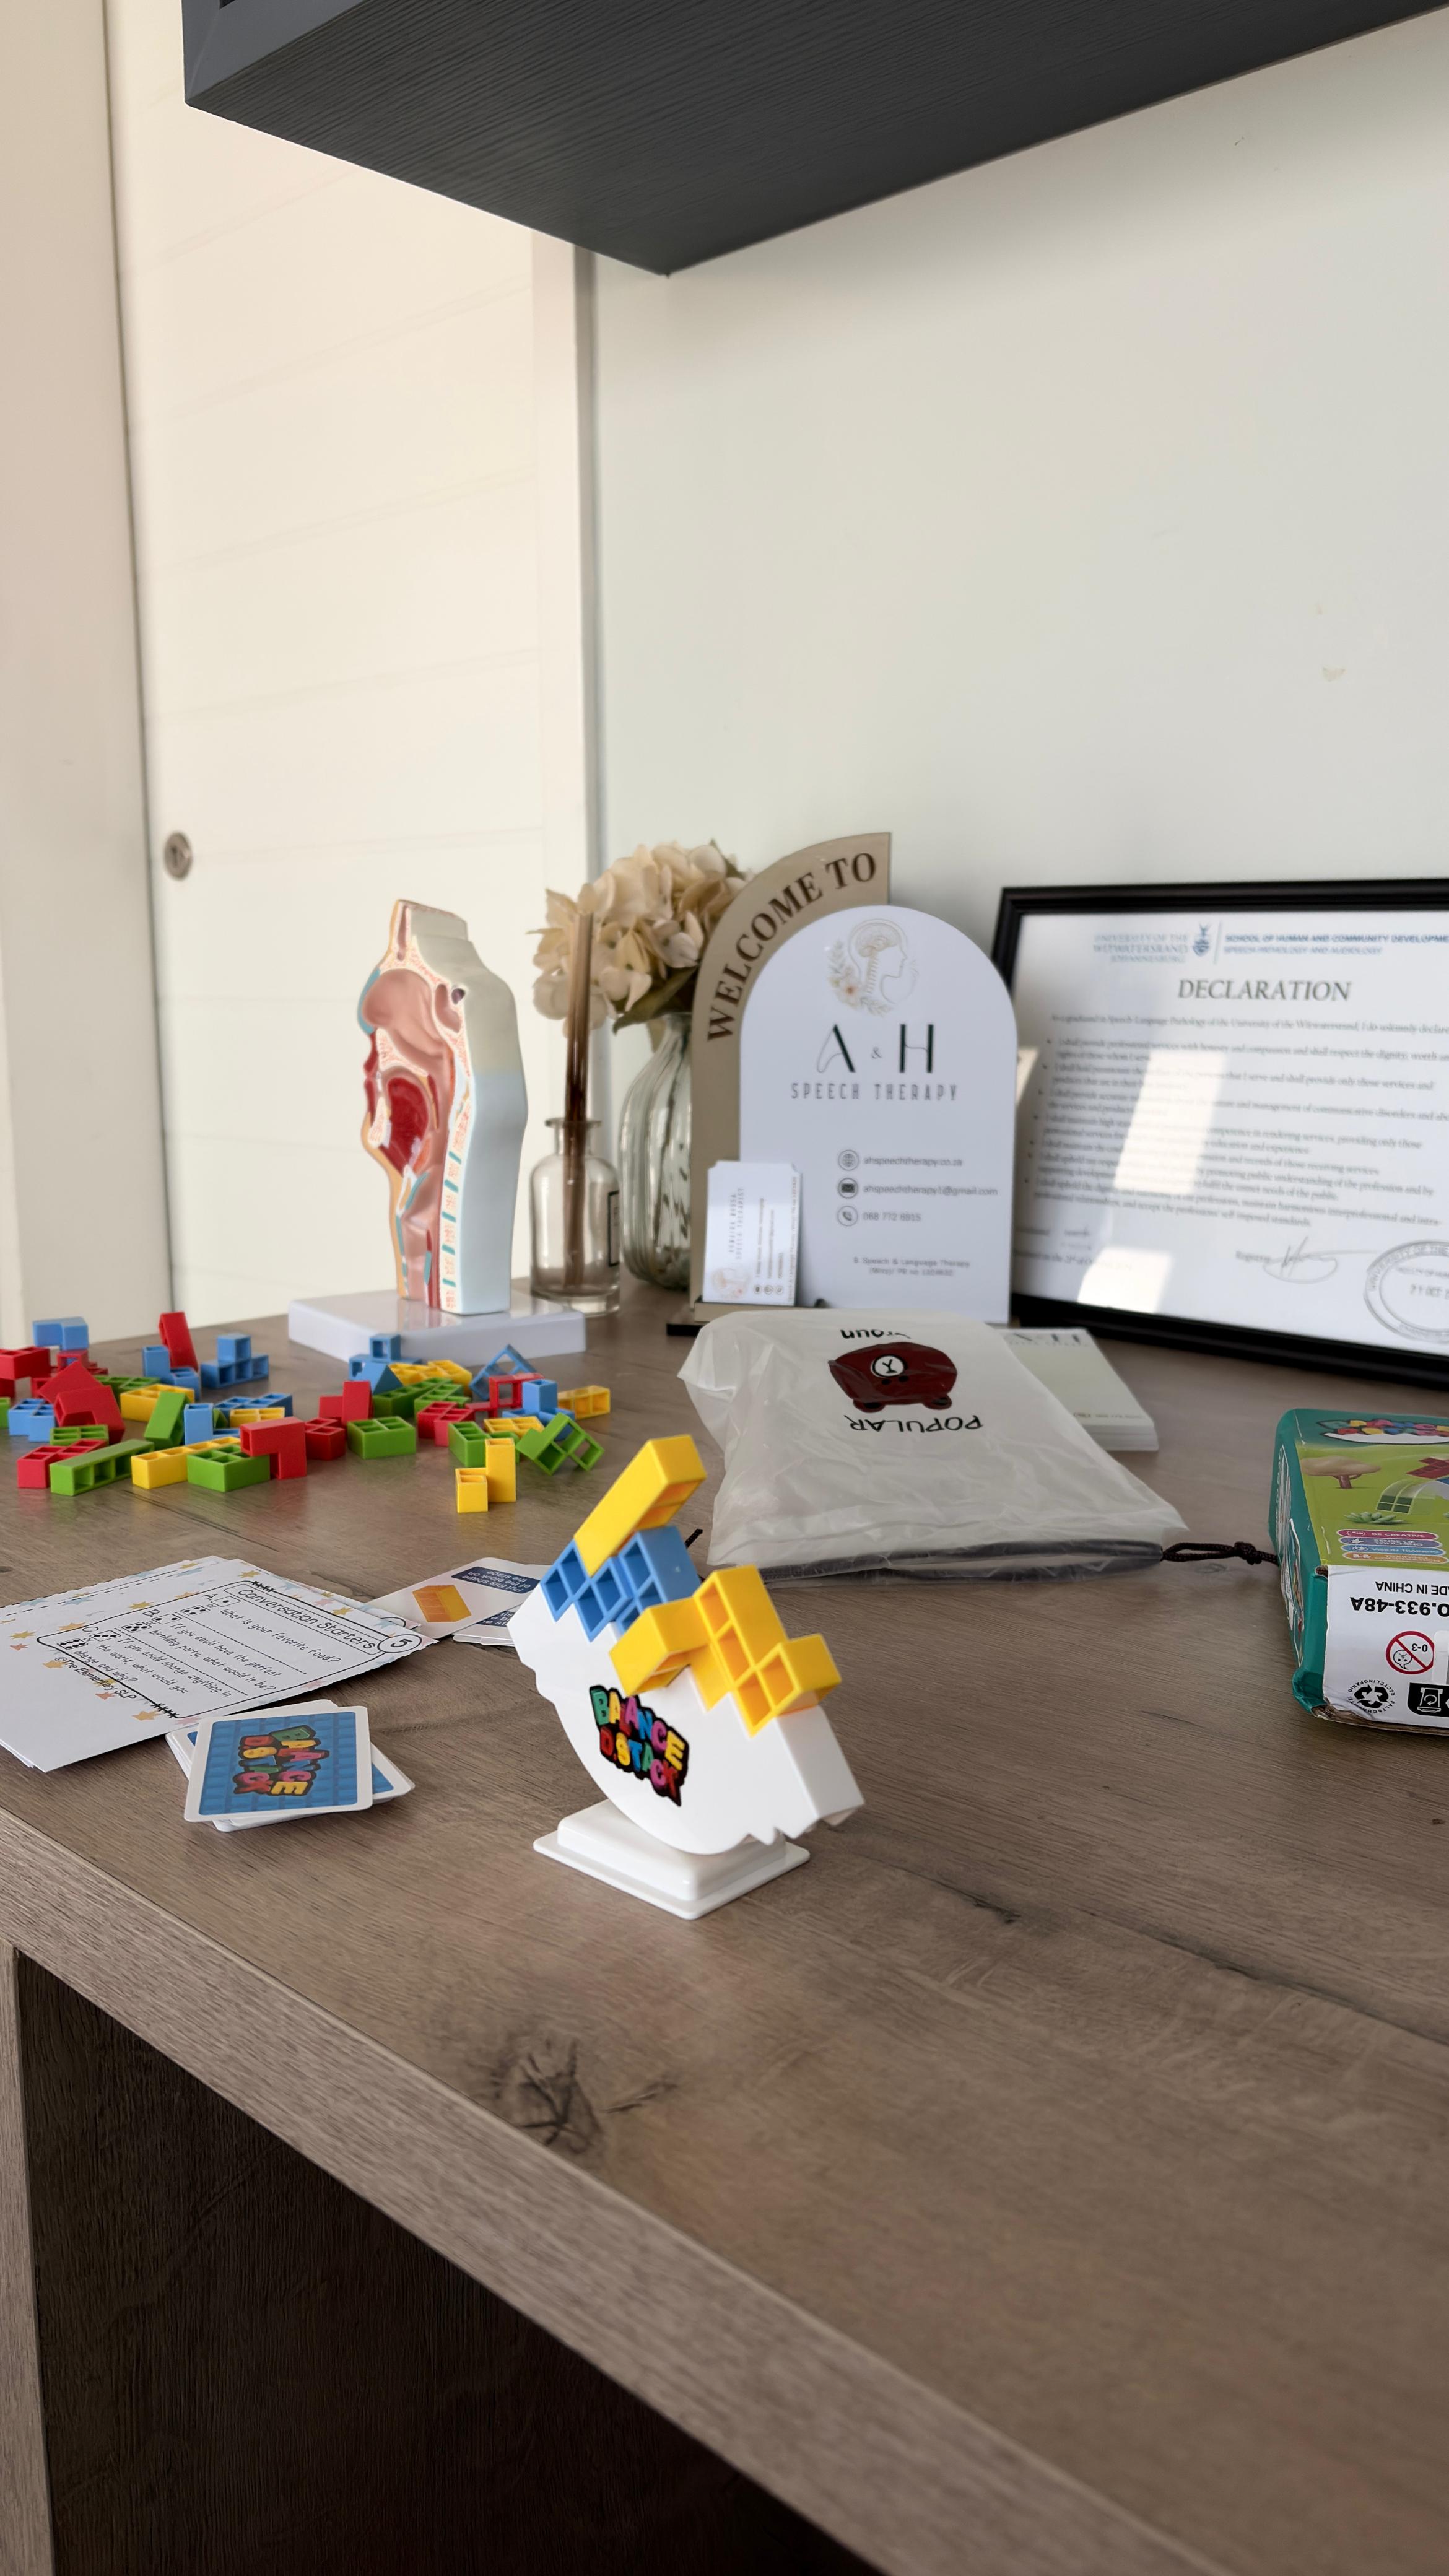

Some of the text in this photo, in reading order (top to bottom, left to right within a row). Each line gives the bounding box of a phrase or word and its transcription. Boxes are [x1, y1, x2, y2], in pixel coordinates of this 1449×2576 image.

[707, 853, 877, 1042] WELCOME TO
[1332, 935, 1388, 944] COMMUNITY
[1391, 935, 1449, 944] DEVELOPME
[1177, 978, 1352, 1002] DECLARATION
[817, 1024, 934, 1074] A & H
[791, 1082, 958, 1101] SPEECH THERAPY
[843, 1415, 983, 1433] POPULAR
[461, 1575, 523, 1593] Put this shape
[482, 1575, 505, 1583] block
[486, 1570, 512, 1579] stage
[201, 1593, 215, 1601] A.
[1375, 1581, 1449, 1596] DE IN CHINA
[142, 1609, 160, 1618] B.
[1349, 1596, 1449, 1617] O.933-48A
[238, 1589, 376, 1650] Conversation Starters
[82, 1626, 99, 1635] C.
[220, 1608, 342, 1663] What is your favorite food?
[170, 1622, 282, 1678] If you could have the perfect
[391, 1638, 412, 1648] 5
[1411, 1643, 1428, 1653] 0-3
[72, 1650, 138, 1682] change and why?
[97, 1644, 189, 1695] the world, what would you
[118, 1636, 231, 1697] If you could change anything in
[149, 1629, 180, 1647] birthday
[177, 1642, 202, 1658] party,
[201, 1655, 222, 1668] what
[222, 1663, 247, 1679] would
[253, 1679, 276, 1691] be?
[74, 1664, 116, 1691] Elementary
[113, 1689, 137, 1700] SLP
[590, 1686, 688, 1772] BALANCE
